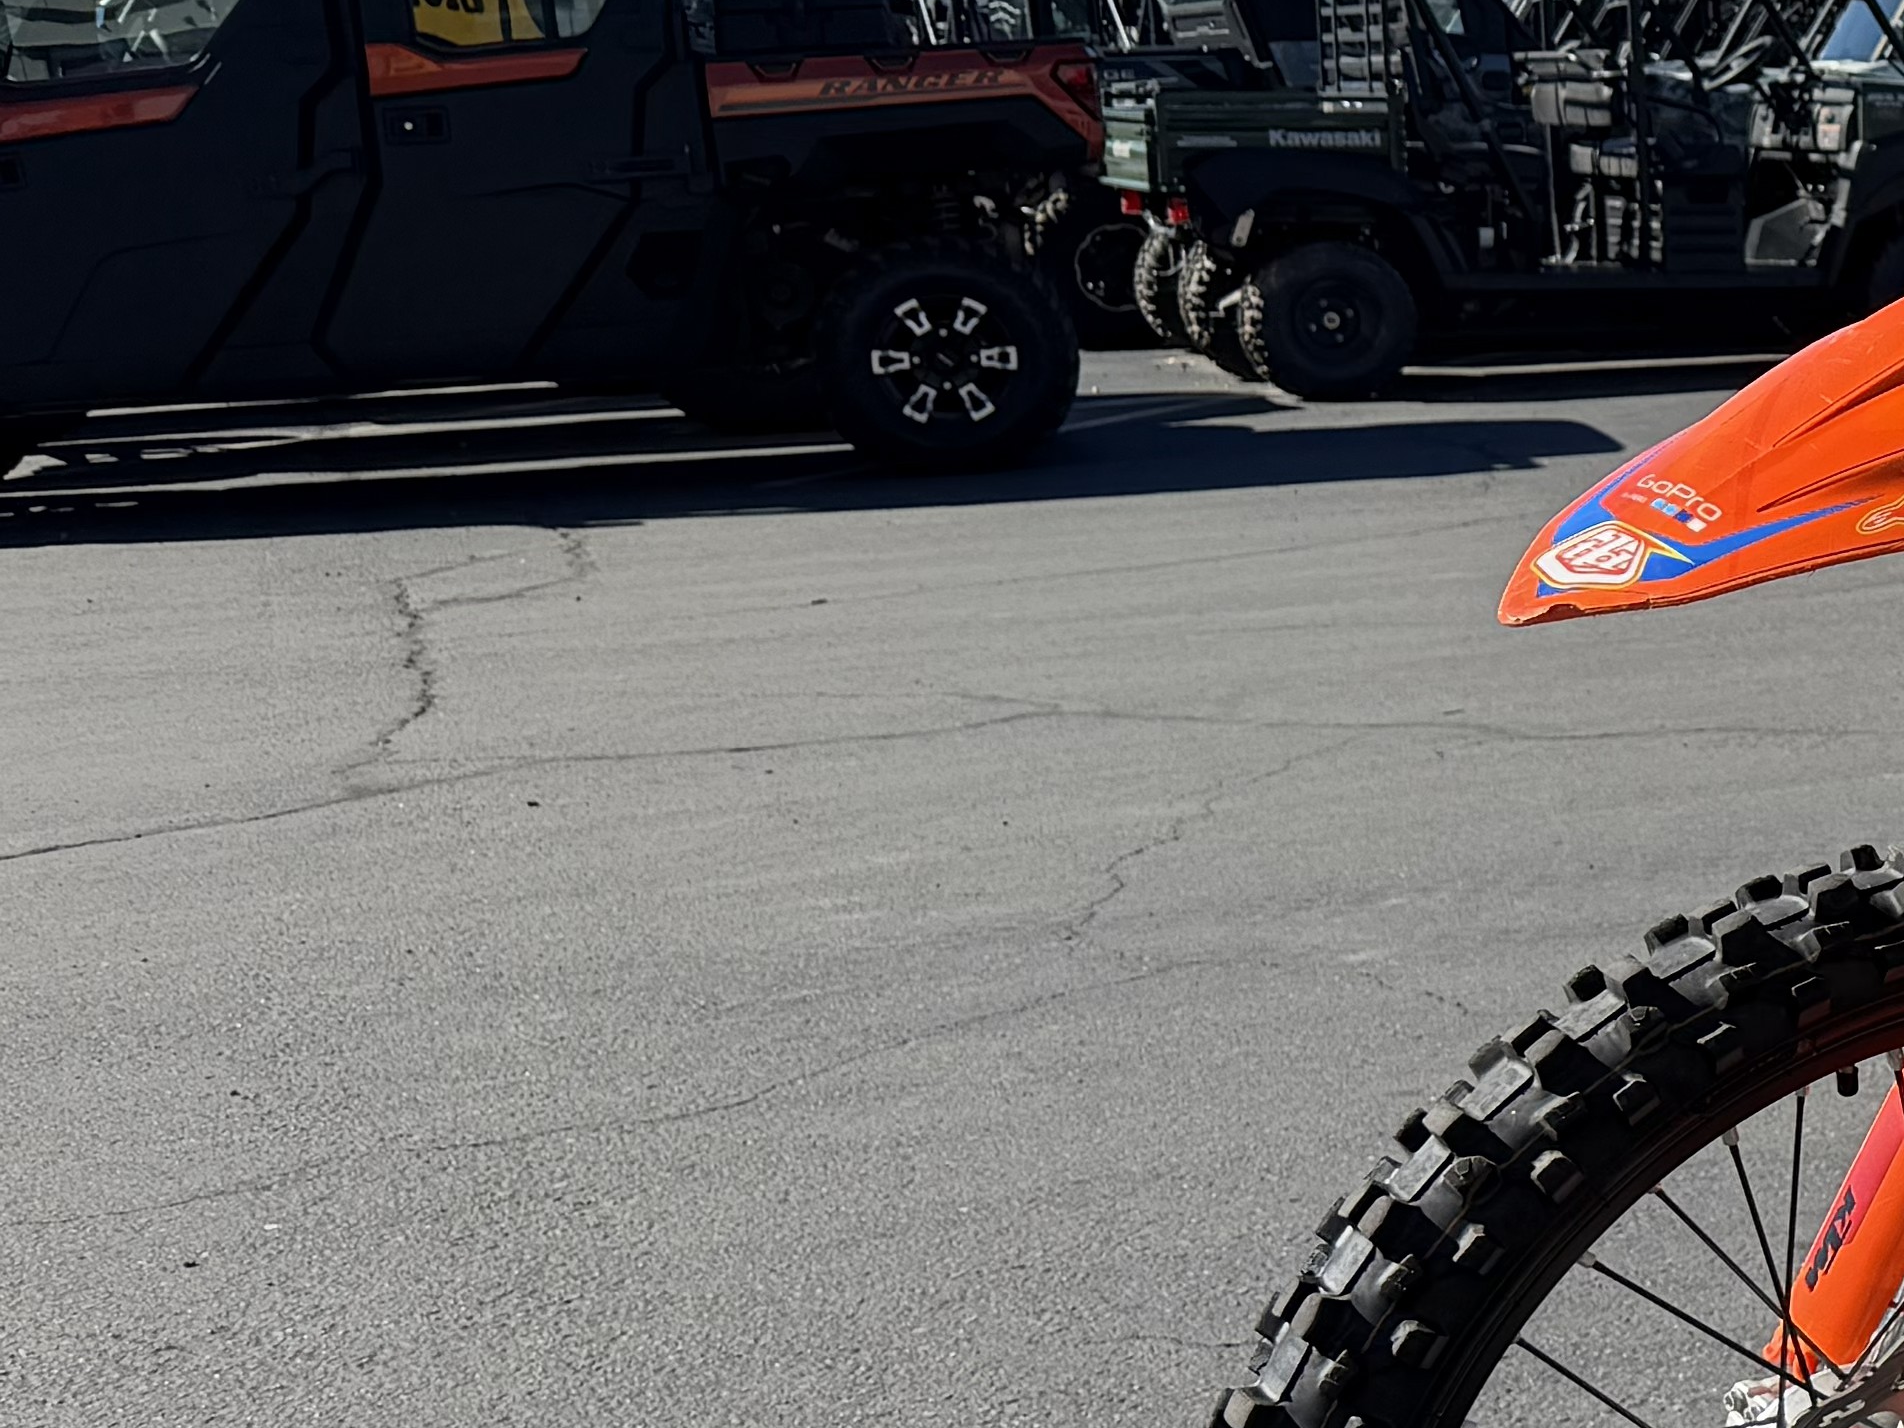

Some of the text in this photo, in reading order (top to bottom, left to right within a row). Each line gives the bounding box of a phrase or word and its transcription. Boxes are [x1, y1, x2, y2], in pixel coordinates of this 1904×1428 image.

[818, 68, 1009, 99] RANGER
[1269, 129, 1382, 148] Kawasaki
[1636, 473, 1723, 522] GoPro
